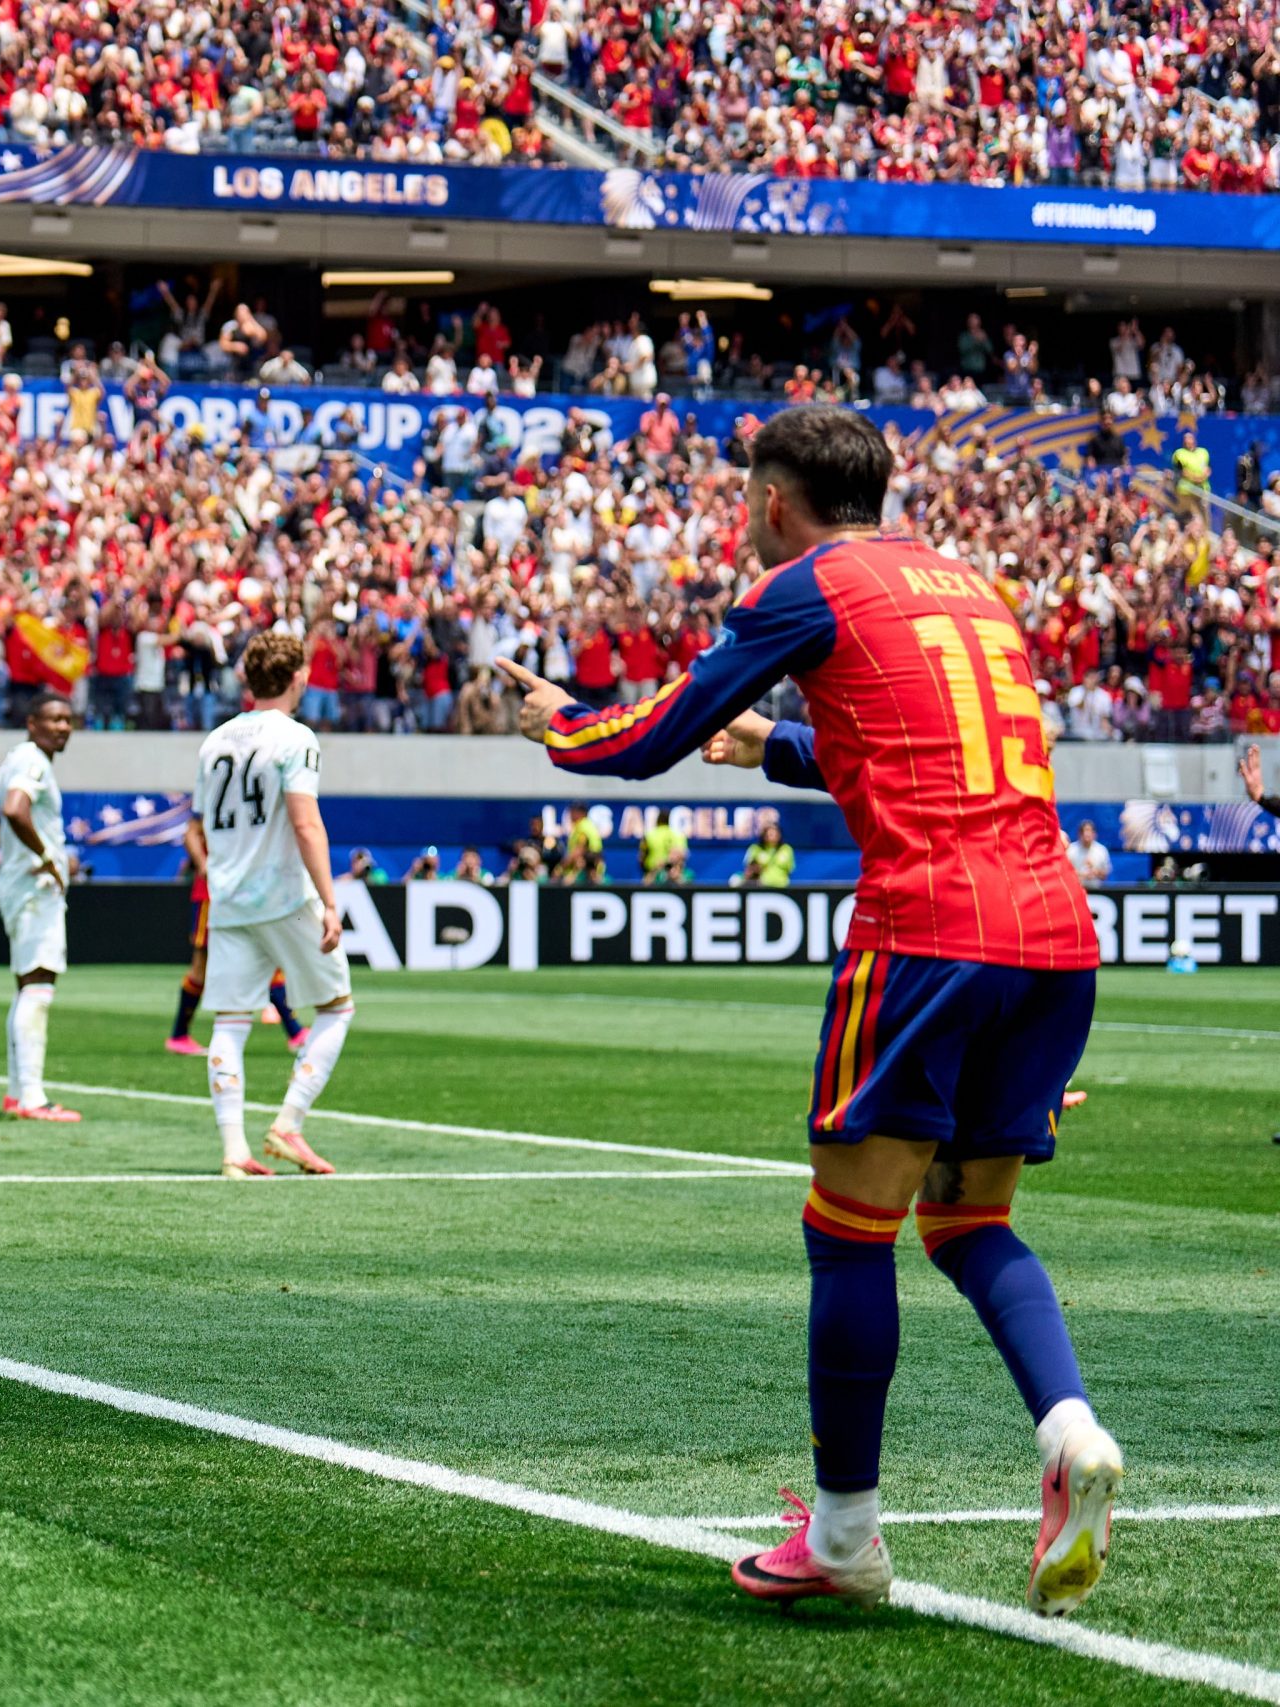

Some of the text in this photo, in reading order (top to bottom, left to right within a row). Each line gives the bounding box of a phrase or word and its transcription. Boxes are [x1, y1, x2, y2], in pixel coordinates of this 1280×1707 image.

[213, 165, 449, 206] LOS ANGELES
[900, 566, 978, 598] ALEX
[911, 614, 1055, 801] 15
[213, 748, 266, 829] 24
